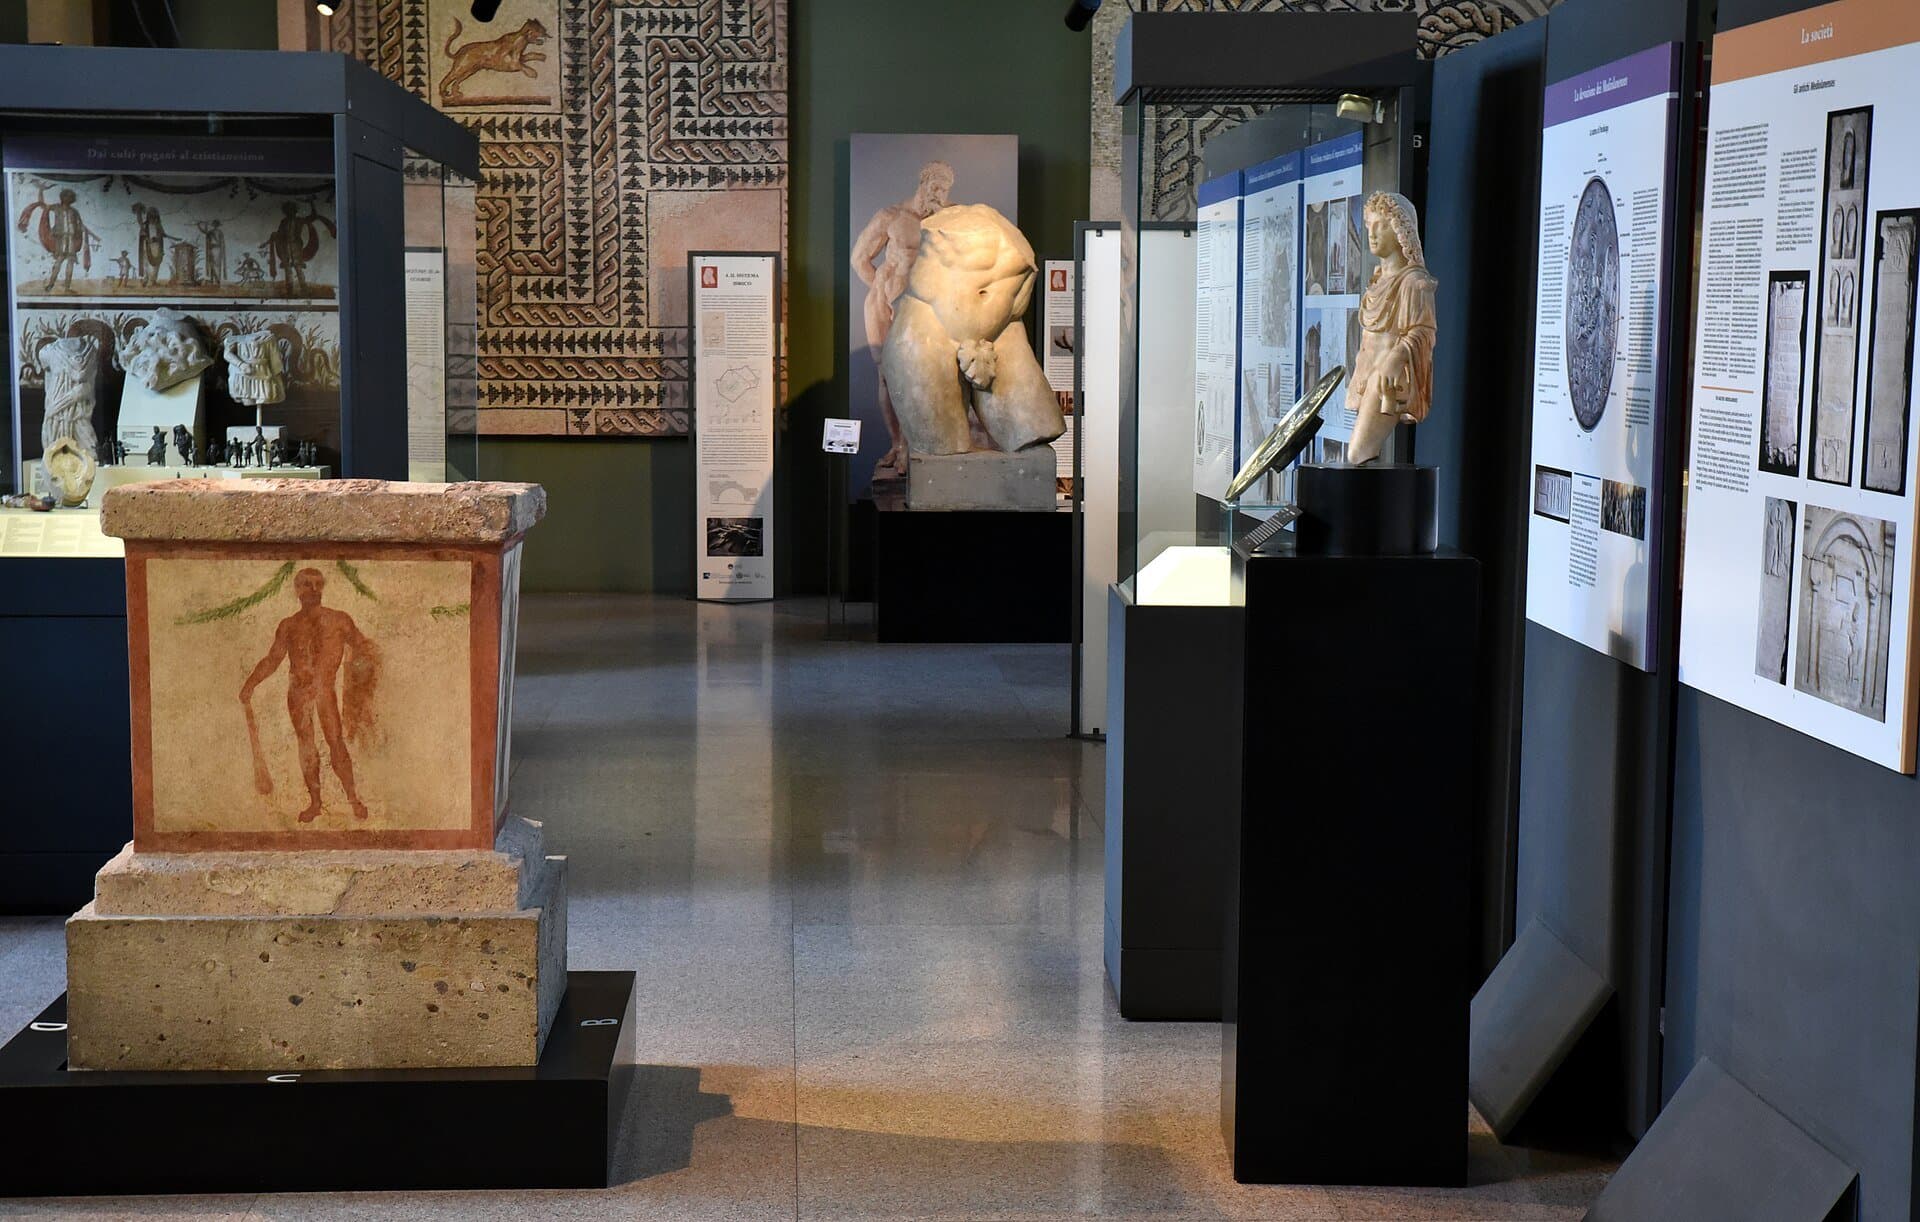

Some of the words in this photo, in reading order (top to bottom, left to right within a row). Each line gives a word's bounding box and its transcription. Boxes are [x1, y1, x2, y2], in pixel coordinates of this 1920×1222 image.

[1801, 27, 1809, 44] La
[1810, 22, 1833, 42] società
[1412, 134, 1422, 148] 6
[87, 148, 107, 159] Dai
[111, 148, 136, 160] culti
[139, 149, 176, 163] pagani
[179, 150, 190, 161] al
[192, 151, 265, 162] cristianesimo
[30, 1022, 68, 1031] D
[581, 1018, 618, 1027] B
